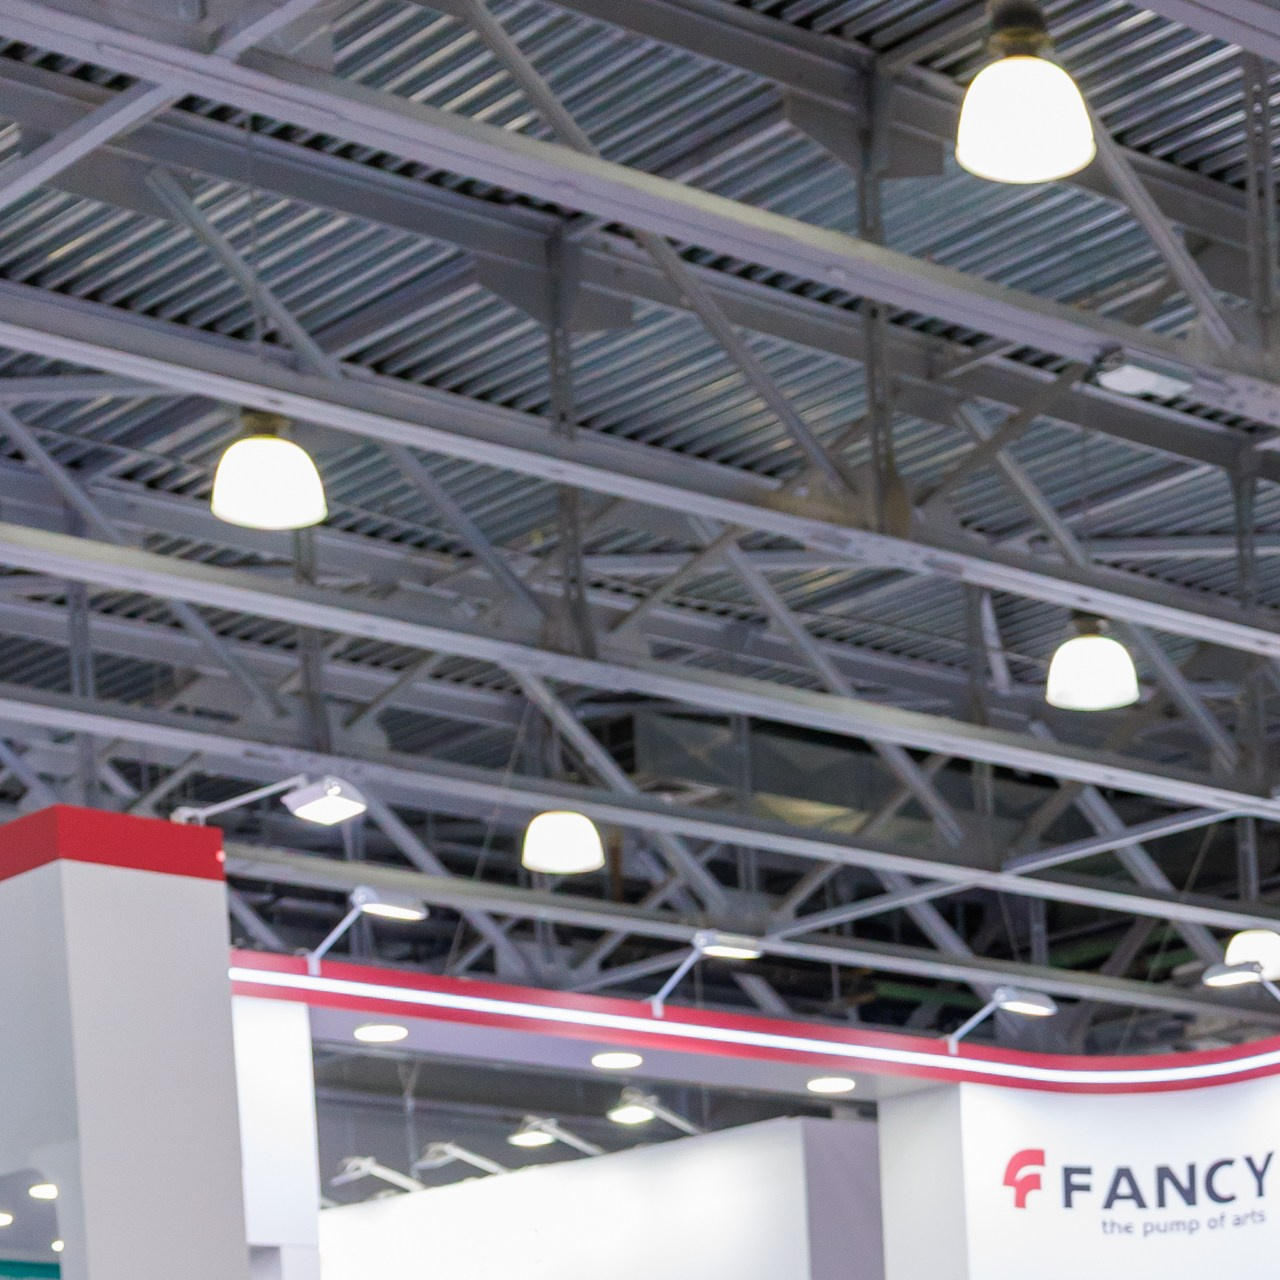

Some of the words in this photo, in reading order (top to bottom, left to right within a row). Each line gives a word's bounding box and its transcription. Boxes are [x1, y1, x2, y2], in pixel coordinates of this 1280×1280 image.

[1062, 1151, 1275, 1209] FANCY
[1101, 1219, 1134, 1235] the
[1143, 1219, 1201, 1237] pump
[1207, 1213, 1227, 1230] of
[1233, 1209, 1266, 1227] arts
